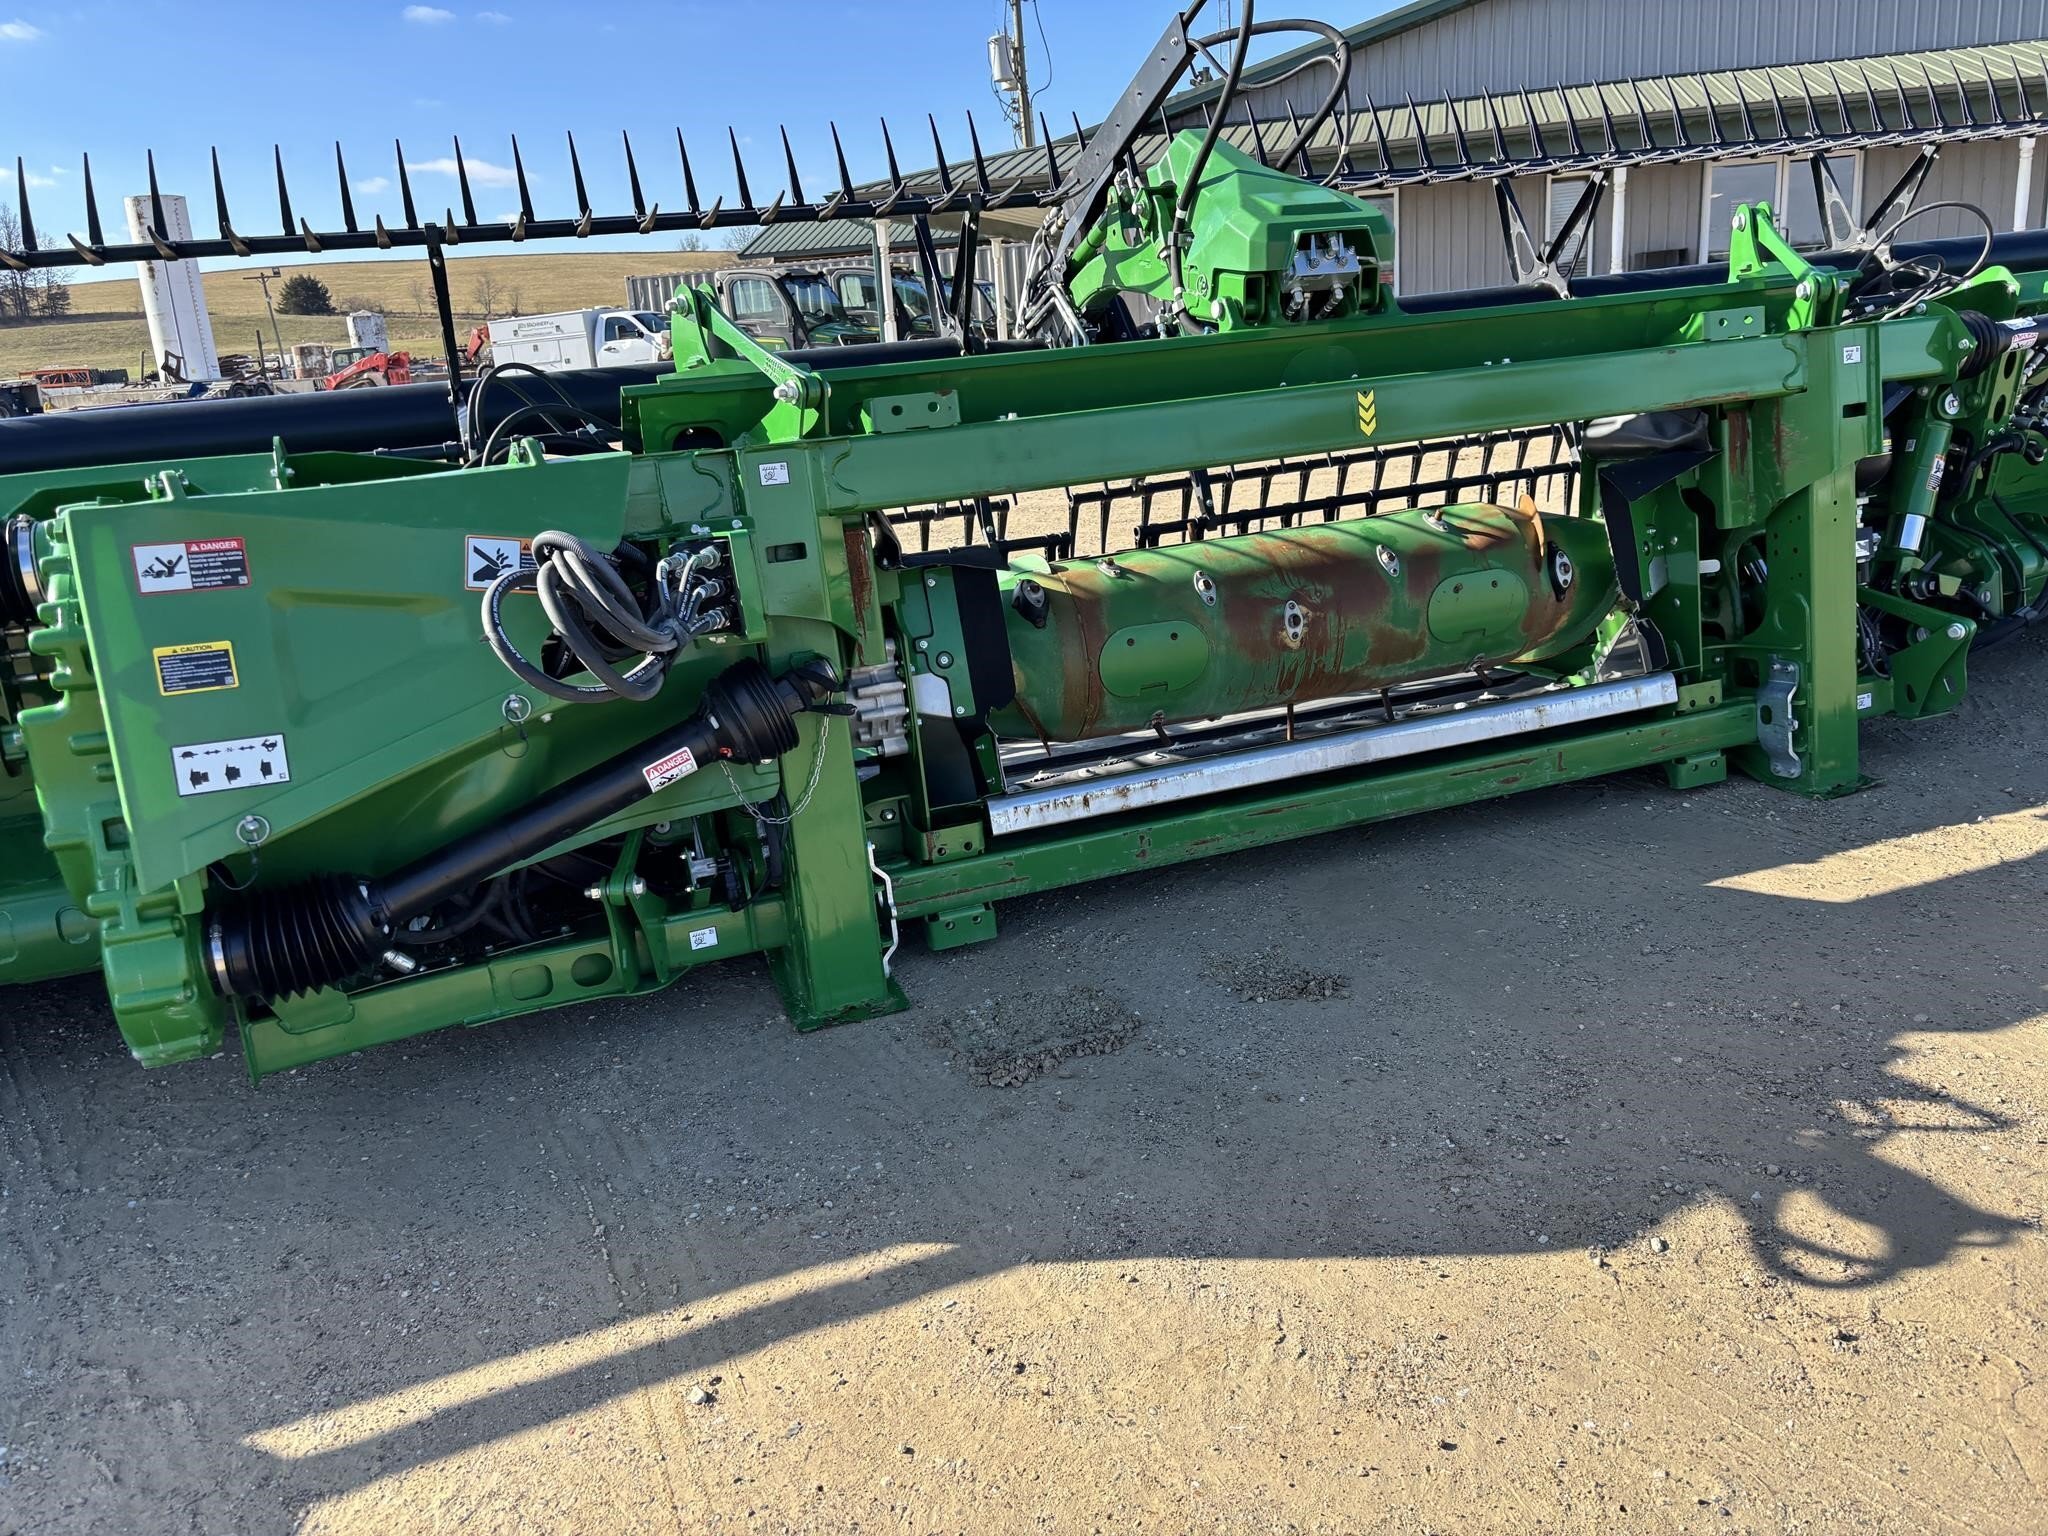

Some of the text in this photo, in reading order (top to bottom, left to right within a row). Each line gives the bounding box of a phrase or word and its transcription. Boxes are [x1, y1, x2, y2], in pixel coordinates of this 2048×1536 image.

[200, 541, 238, 551] DANGER
[180, 644, 213, 653] CAUTION
[657, 752, 690, 773] DANGER
